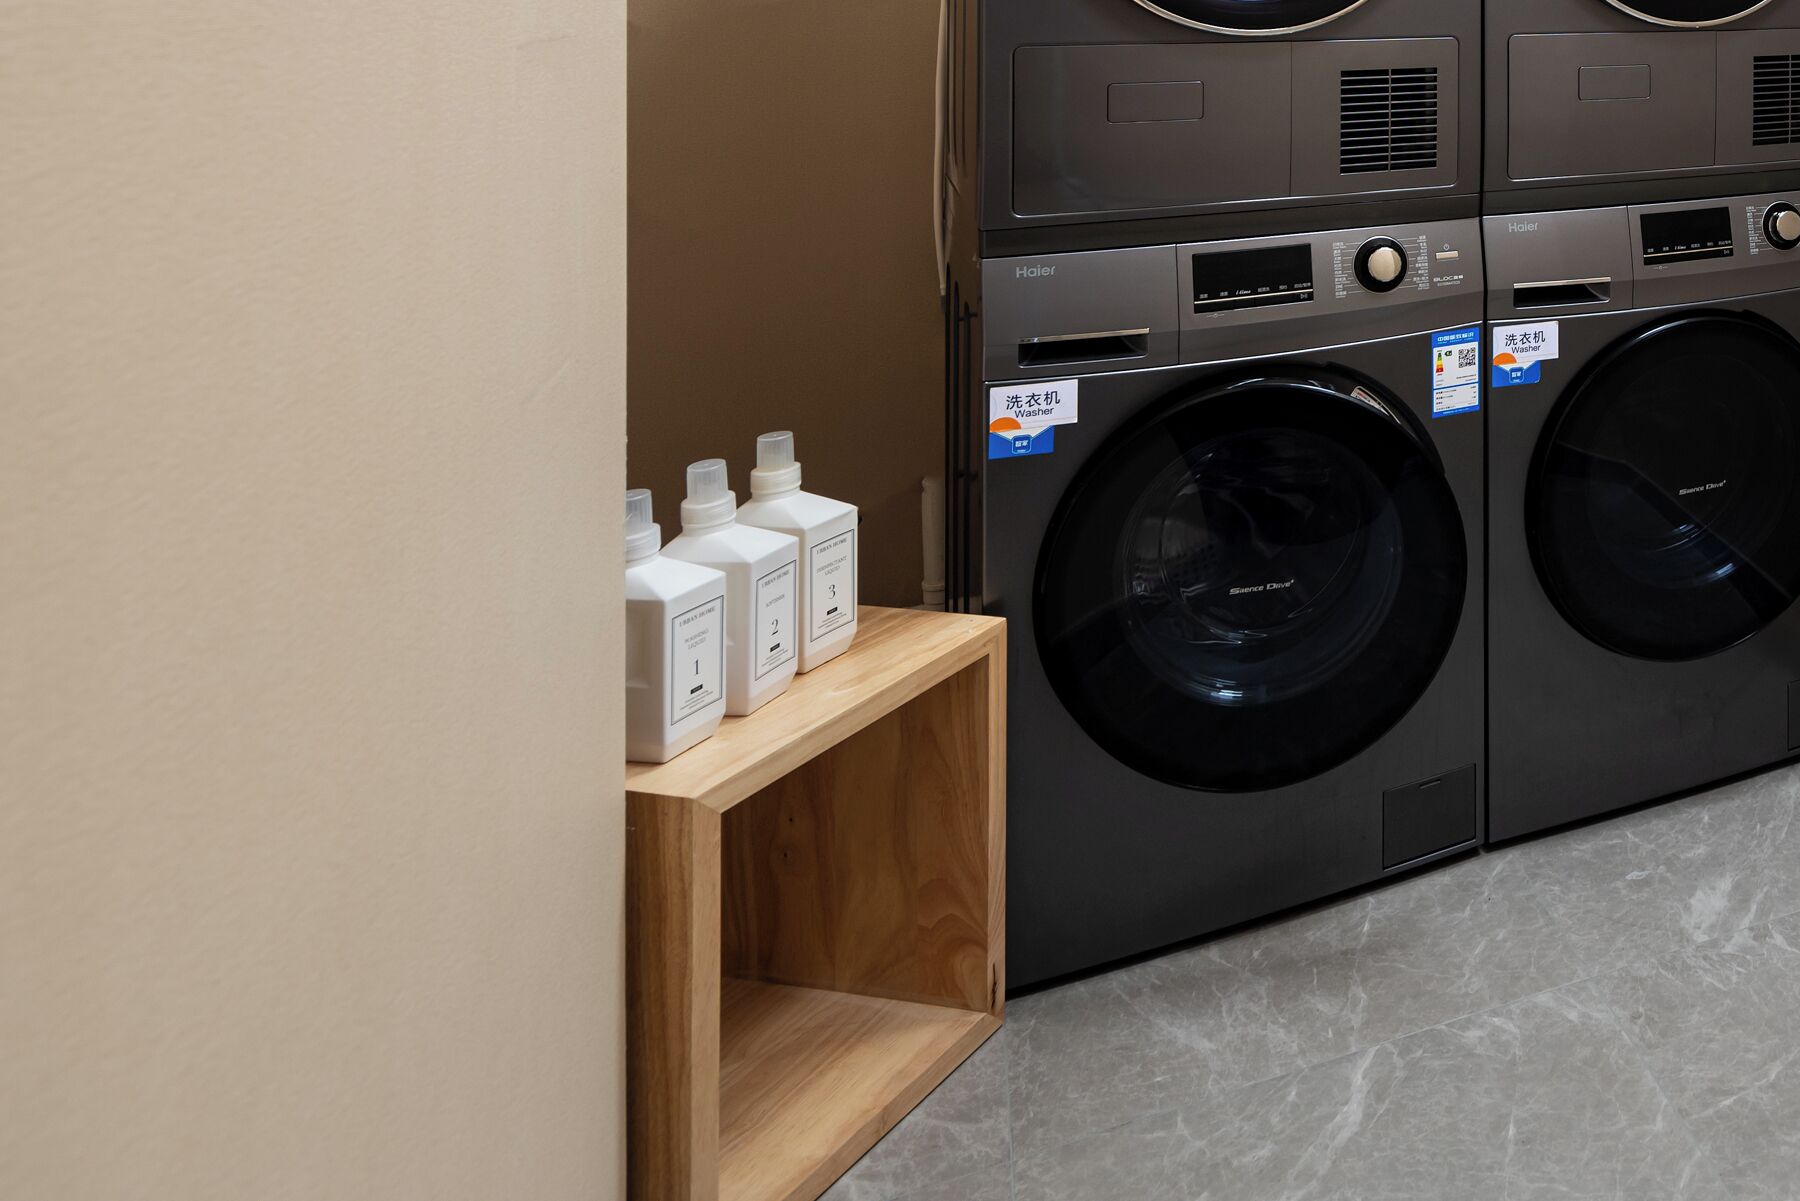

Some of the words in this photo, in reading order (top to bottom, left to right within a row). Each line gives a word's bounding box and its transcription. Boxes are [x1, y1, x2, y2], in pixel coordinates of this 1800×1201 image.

[1508, 221, 1539, 233] Haier
[1016, 265, 1056, 278] Haier
[1505, 330, 1546, 347] 洗衣机
[1511, 345, 1542, 354] Washer
[1006, 390, 1061, 410] 洗衣机
[1014, 407, 1055, 419] Washer
[828, 584, 836, 600] 3
[771, 618, 779, 636] 2
[693, 658, 700, 675] 1
